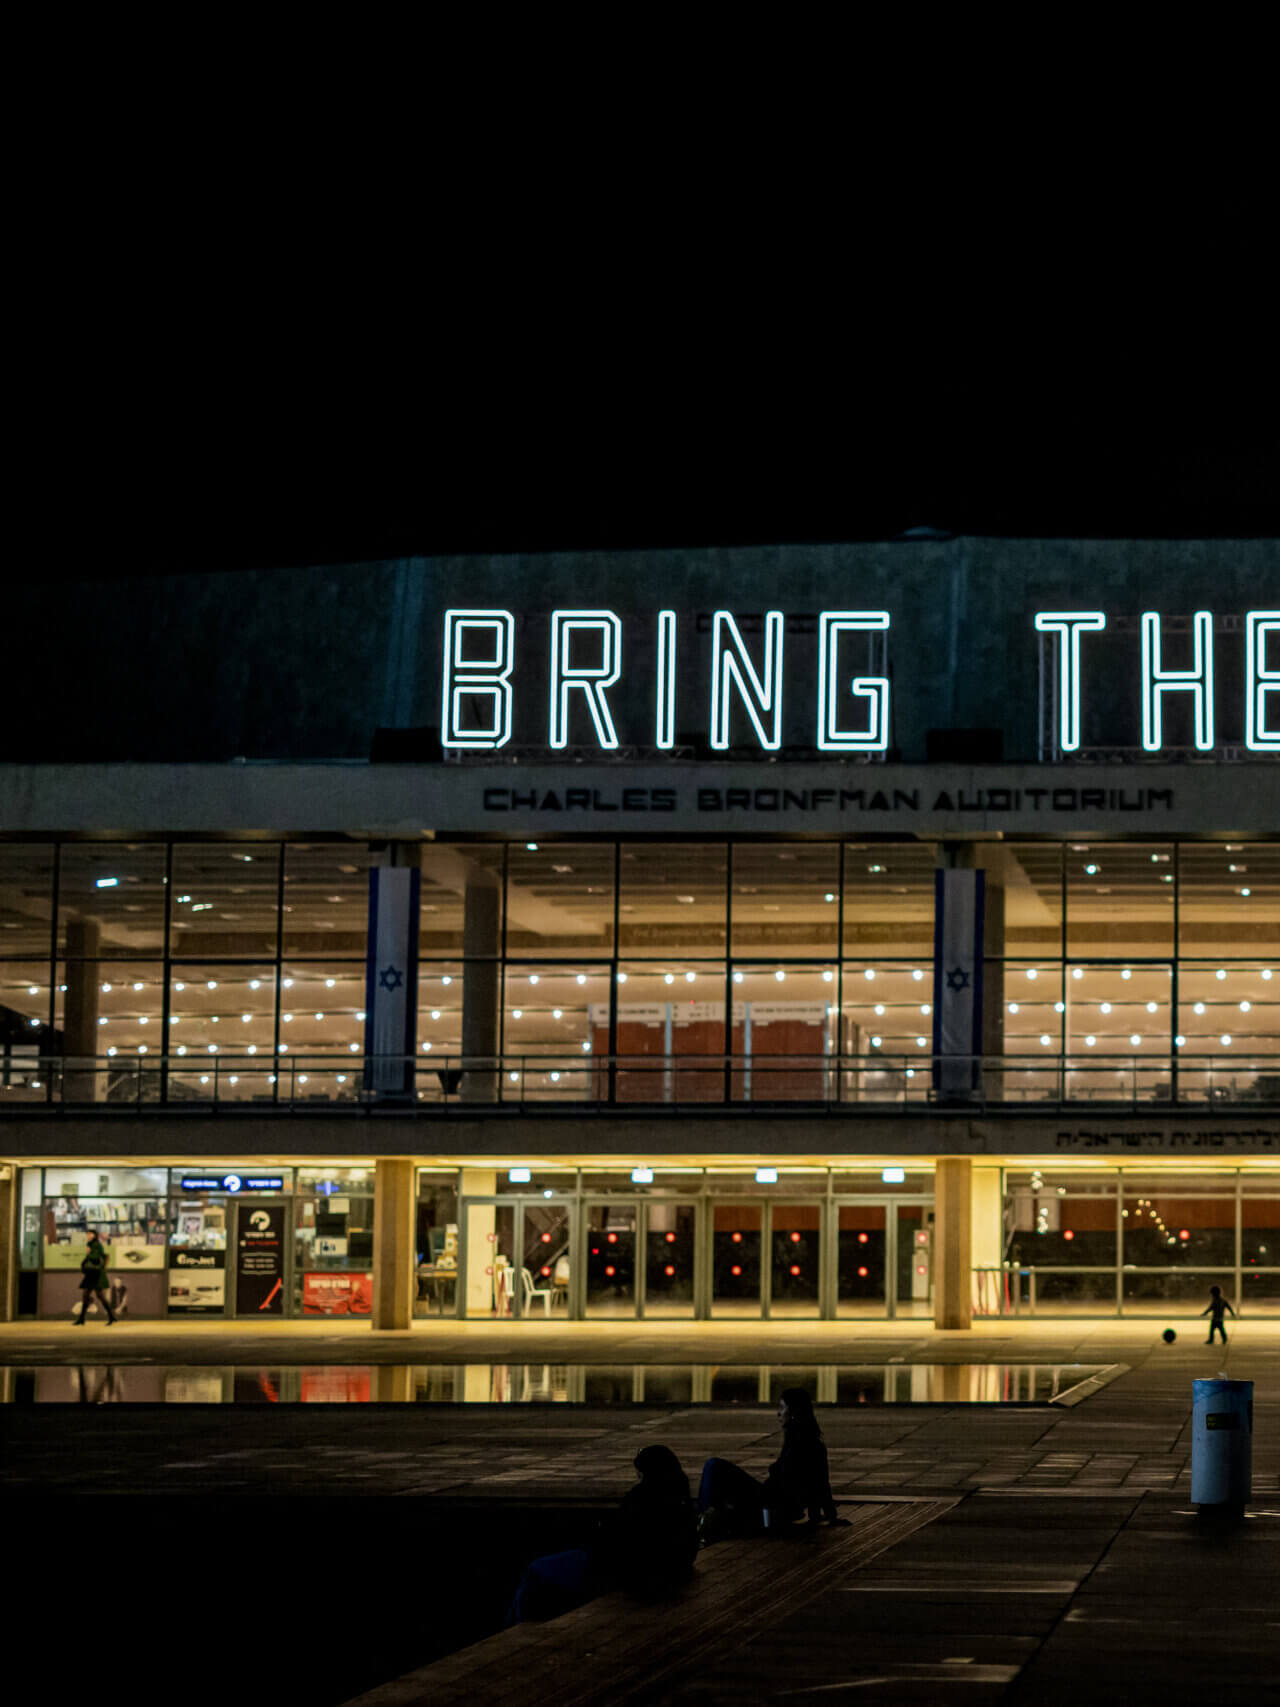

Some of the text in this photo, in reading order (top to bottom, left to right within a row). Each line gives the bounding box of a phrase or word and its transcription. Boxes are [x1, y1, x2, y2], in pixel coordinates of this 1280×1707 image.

[441, 609, 890, 750] BRING
[483, 787, 1175, 812] CHARLES BRONFMAN AUDITORIUM
[1056, 1130, 1164, 1147] הישראלית
